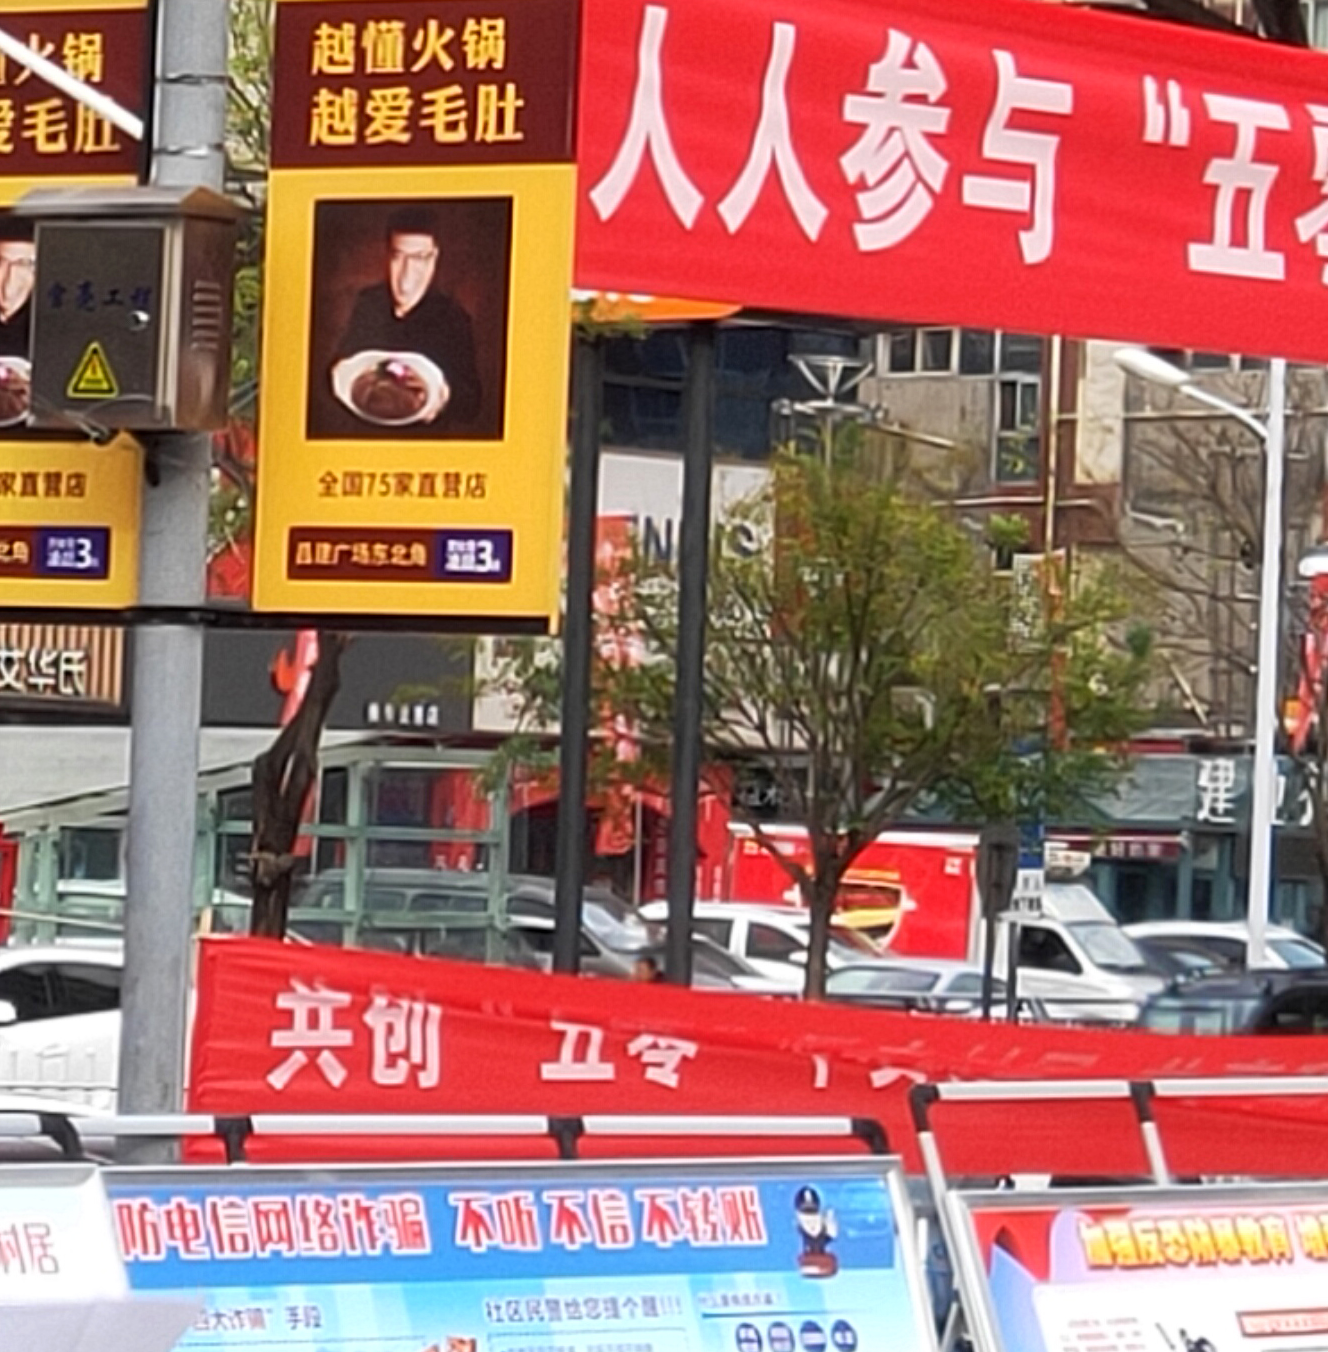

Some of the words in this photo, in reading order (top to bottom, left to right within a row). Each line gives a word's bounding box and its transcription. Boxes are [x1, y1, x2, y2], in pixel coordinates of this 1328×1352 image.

[311, 17, 507, 76] 越懂火锅
[310, 82, 525, 147] 越爱毛肚
[318, 470, 488, 498] 全国75家直营店
[267, 977, 442, 1089] 共创
[118, 1194, 431, 1261] 防电信网络诈骗
[453, 1190, 541, 1253] 不听
[550, 1188, 631, 1250] 不信
[643, 1185, 769, 1250] 不转账
